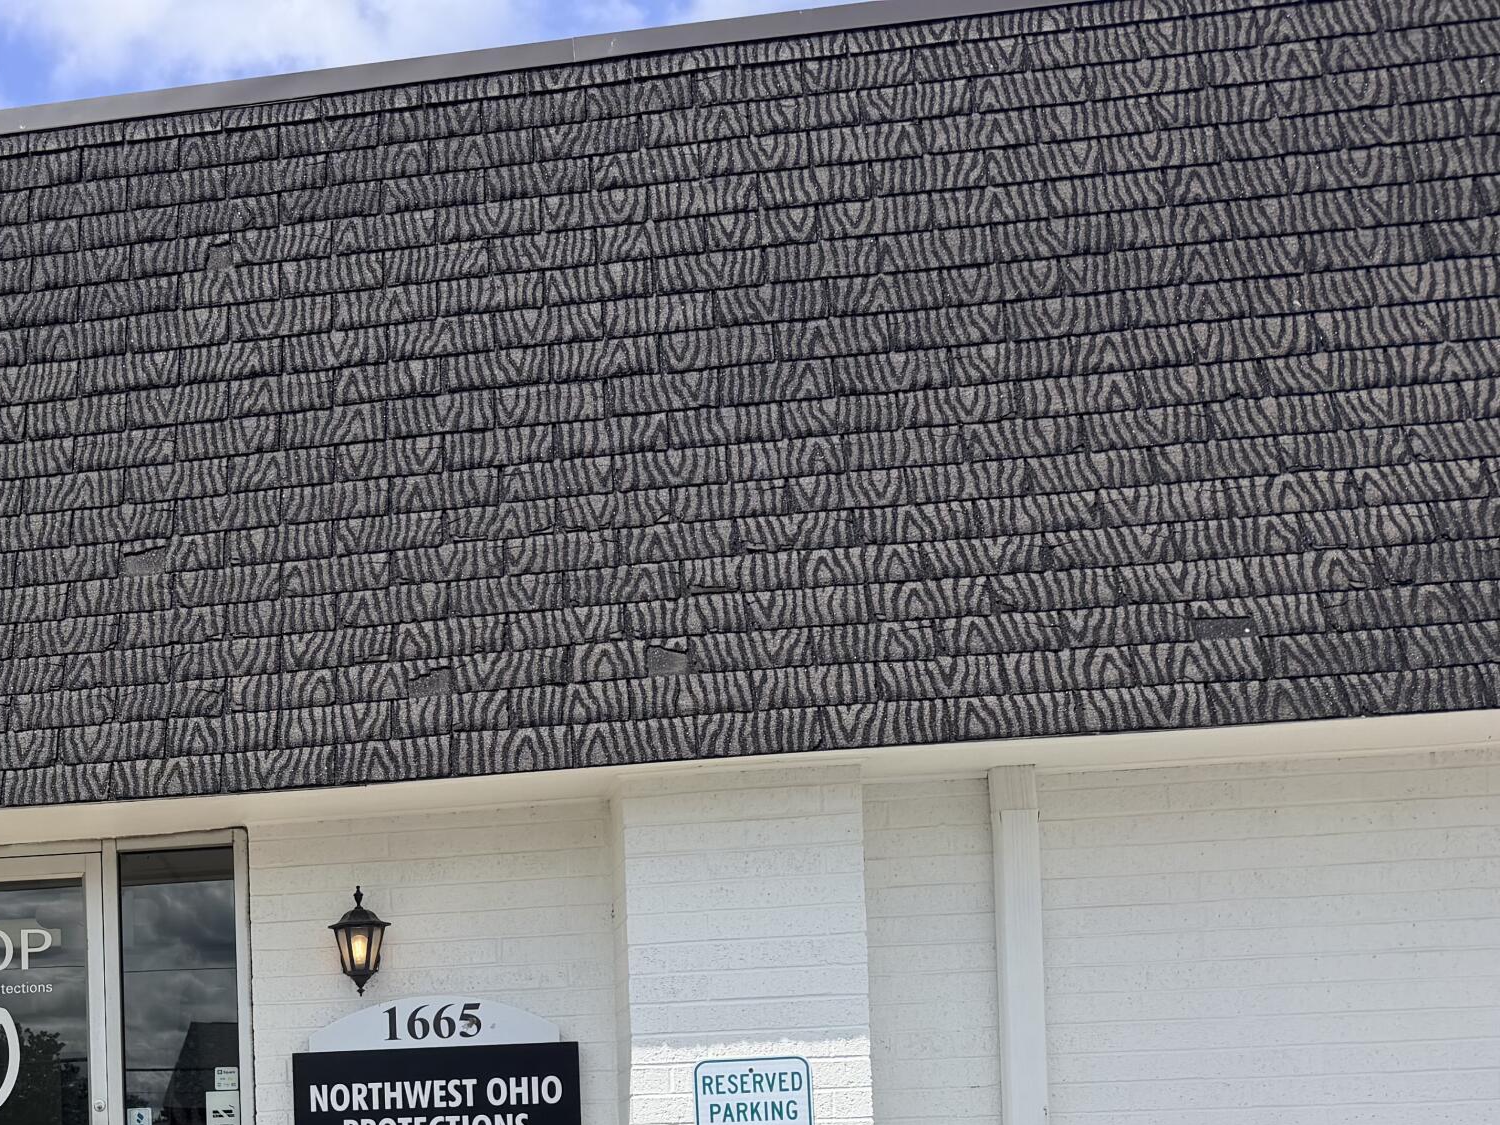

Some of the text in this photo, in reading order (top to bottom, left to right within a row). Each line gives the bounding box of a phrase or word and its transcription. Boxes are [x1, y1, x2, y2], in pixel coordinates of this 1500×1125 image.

[383, 1003, 481, 1040] 1665
[309, 1075, 563, 1112] NORTHWEST OHIO
[702, 1071, 803, 1095] RESERVED
[710, 1100, 798, 1123] PARKING
